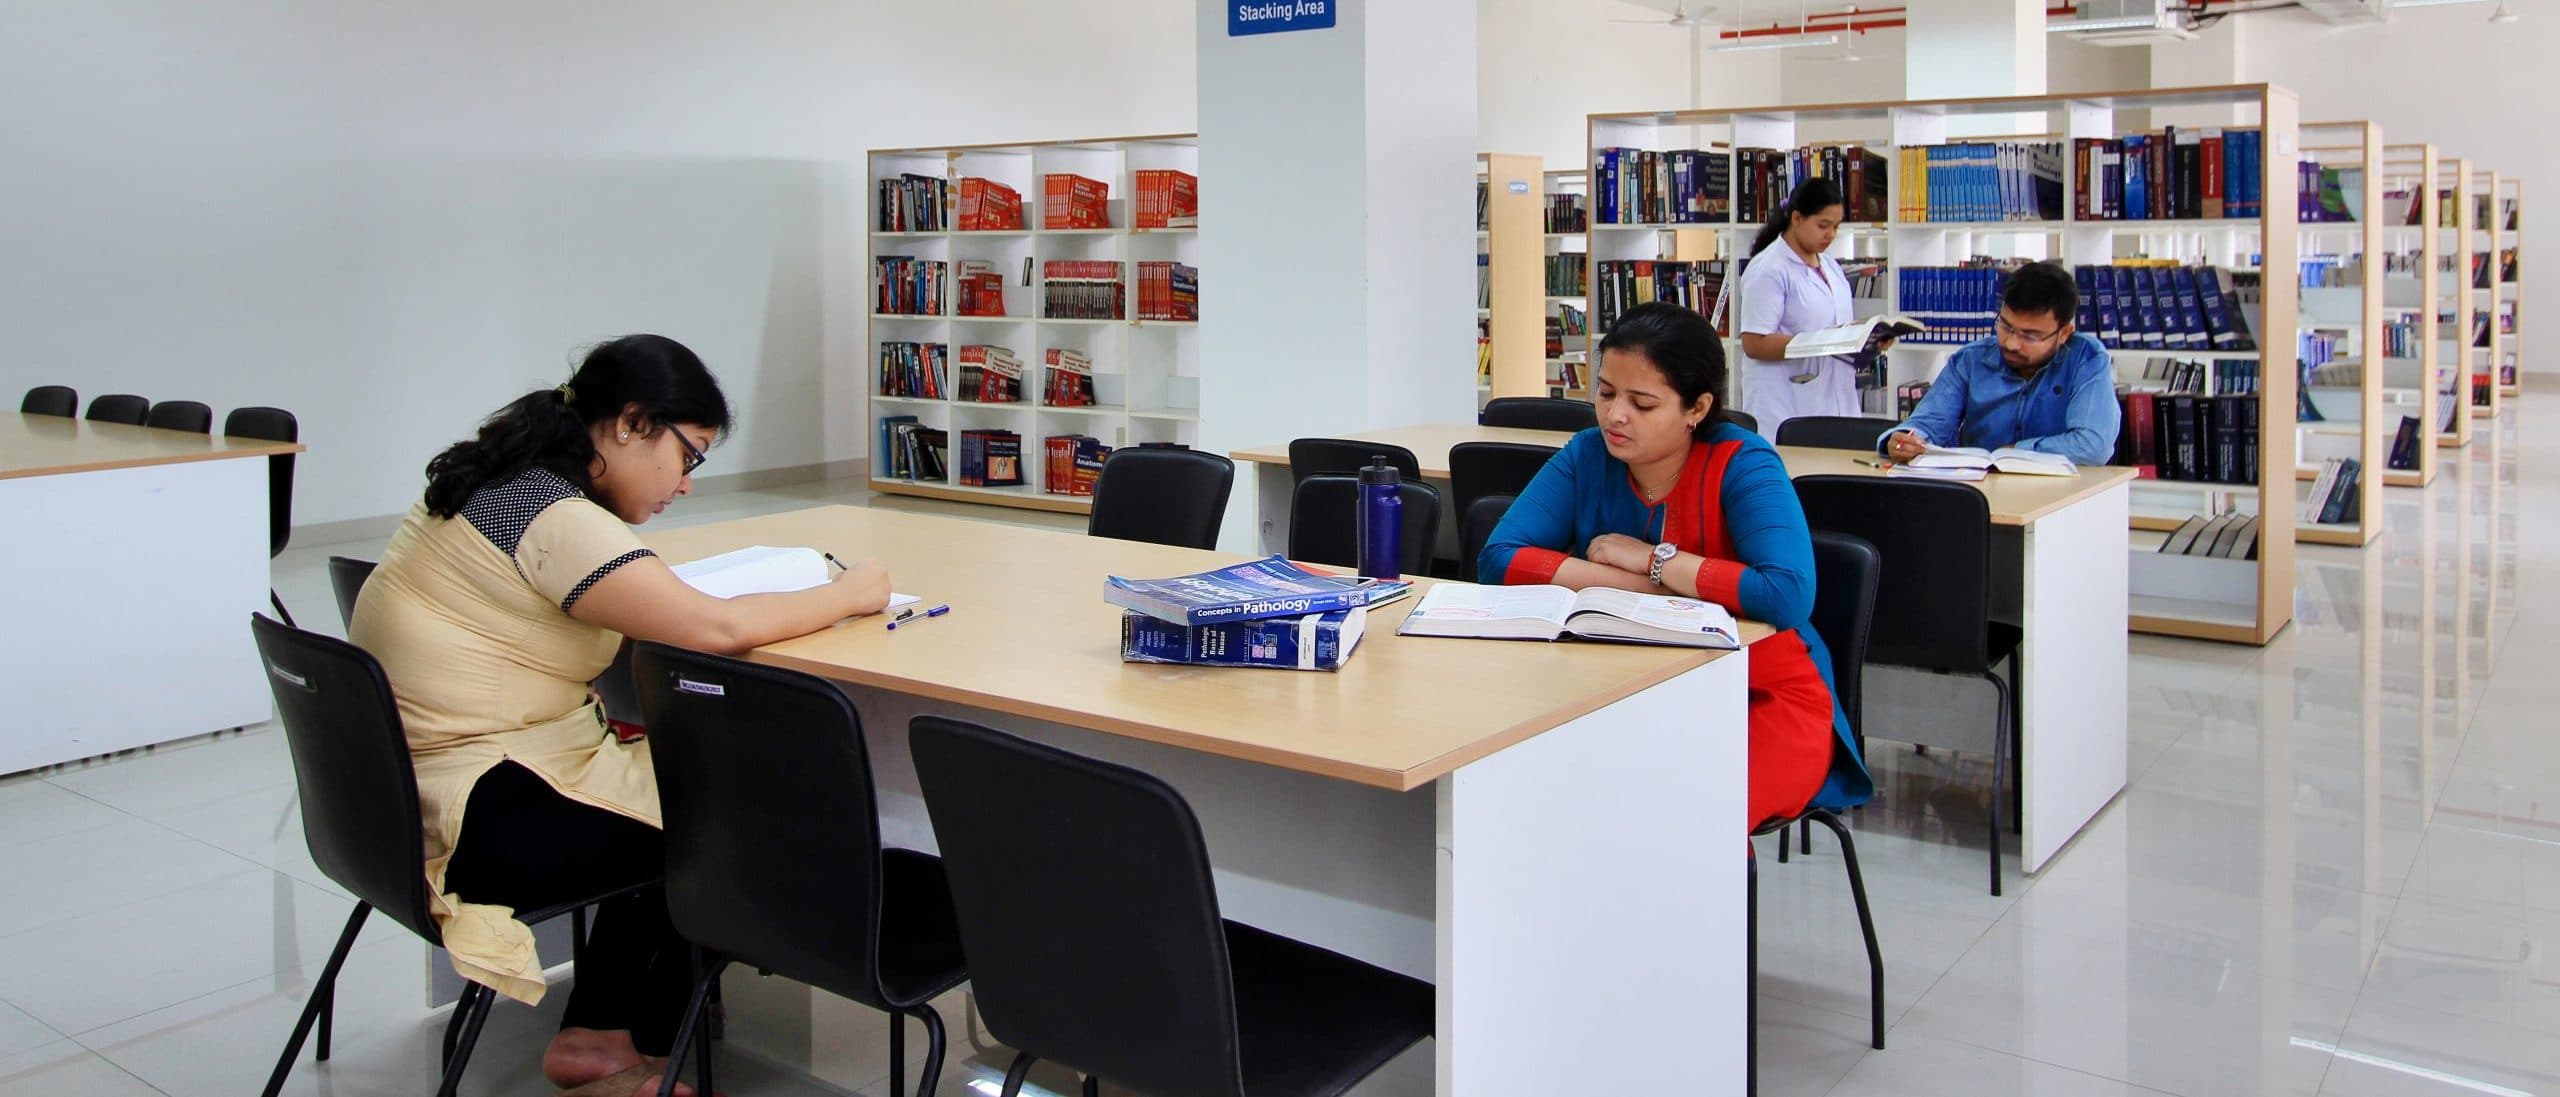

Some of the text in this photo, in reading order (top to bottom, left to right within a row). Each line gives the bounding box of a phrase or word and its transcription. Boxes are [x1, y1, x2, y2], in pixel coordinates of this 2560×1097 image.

[1239, 0, 1325, 21] Stacking Area
[1076, 458, 1103, 467] Anatom
[1197, 607, 1233, 618] Concepts
[1243, 599, 1312, 615] Pathology
[1200, 626, 1210, 658] Pathologic
[1218, 631, 1226, 656] Disease
